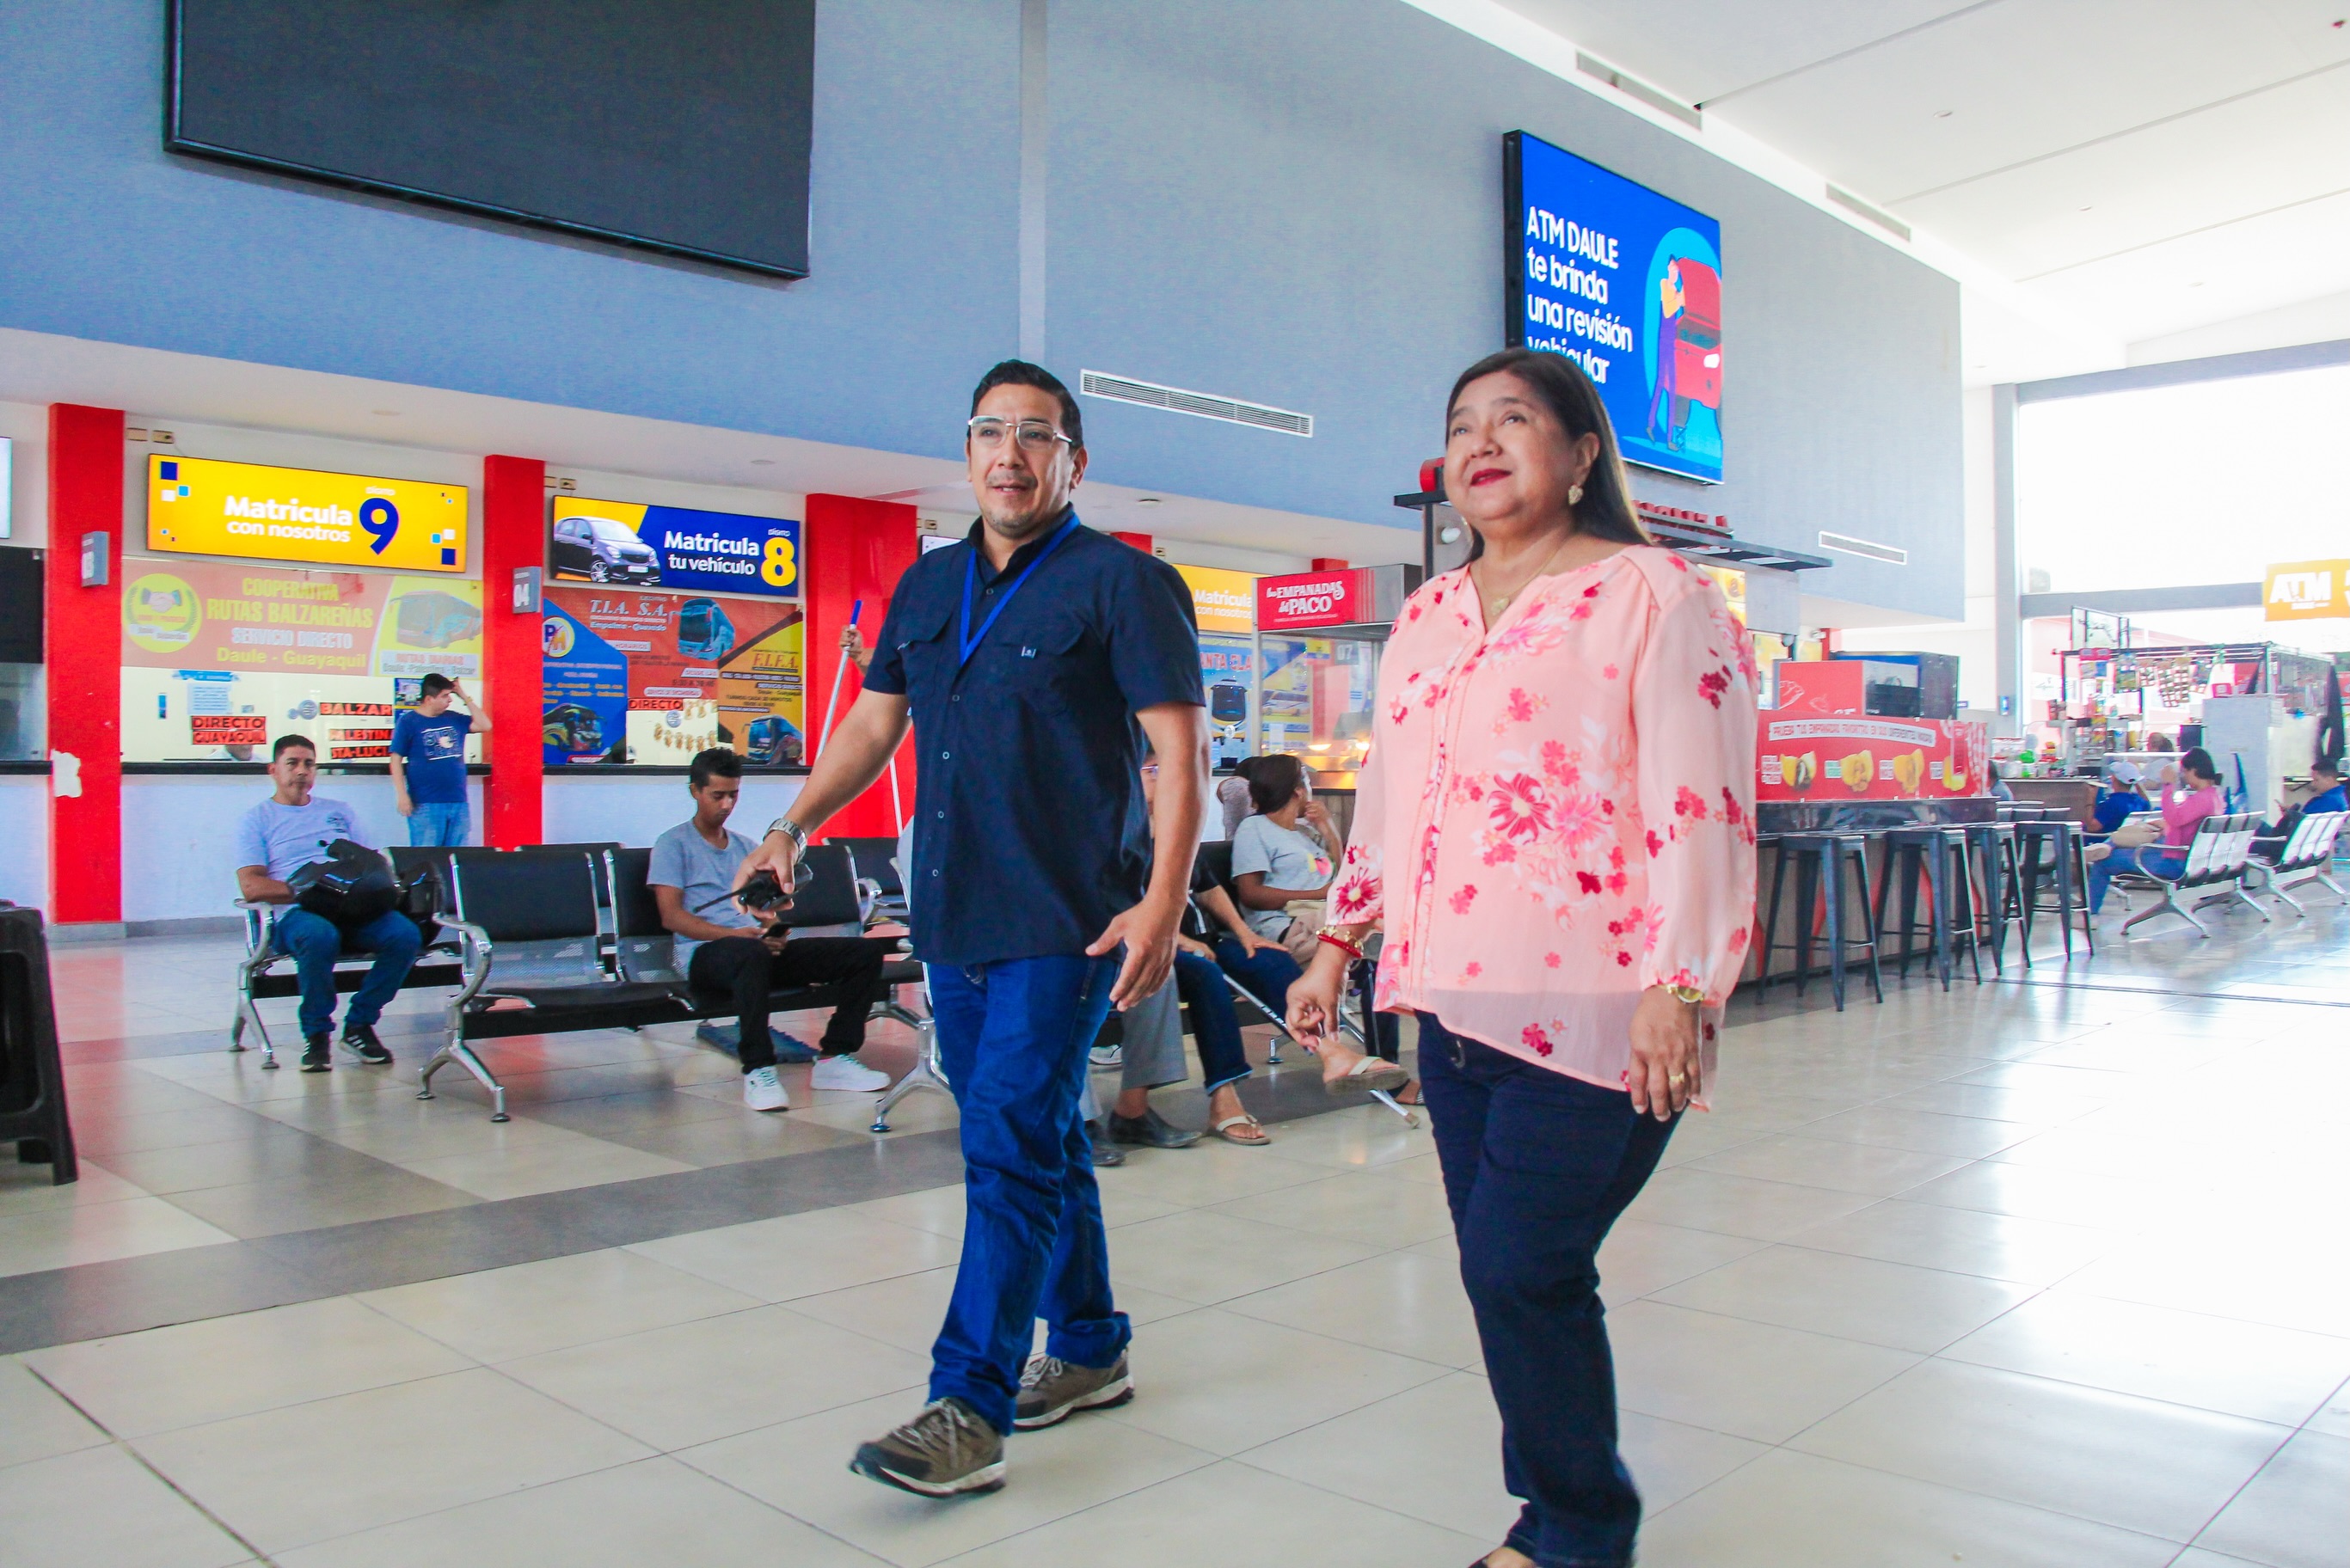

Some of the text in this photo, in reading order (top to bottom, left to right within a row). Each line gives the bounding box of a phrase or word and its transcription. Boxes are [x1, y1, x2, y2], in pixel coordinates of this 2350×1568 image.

[1526, 206, 1619, 270] ATM DAULE
[1526, 246, 1609, 304] te brinda
[1527, 294, 1633, 352] una revisión
[224, 496, 399, 555] Matricula 9
[227, 521, 351, 543] con nosotros
[664, 530, 797, 586] Matricula 8
[668, 554, 756, 575] tu vehículo
[242, 577, 340, 601] COOPERATIVA
[1276, 580, 1345, 600] EMPANADAS
[2268, 571, 2332, 603] ATM
[206, 598, 374, 628] RUTAS BALZAREÑAS
[1288, 596, 1332, 615] PACO
[231, 628, 353, 649] SERVICIO DIRECTO
[217, 646, 267, 663] Daule
[283, 650, 366, 670] Guayaquil
[1200, 652, 1227, 669] ANTA
[321, 702, 392, 715] BALZAR
[629, 700, 682, 709] DIRECTO
[192, 718, 263, 728] DIRECTO
[329, 729, 393, 740] PALESTIN
[331, 745, 390, 758] STA-LUCI
